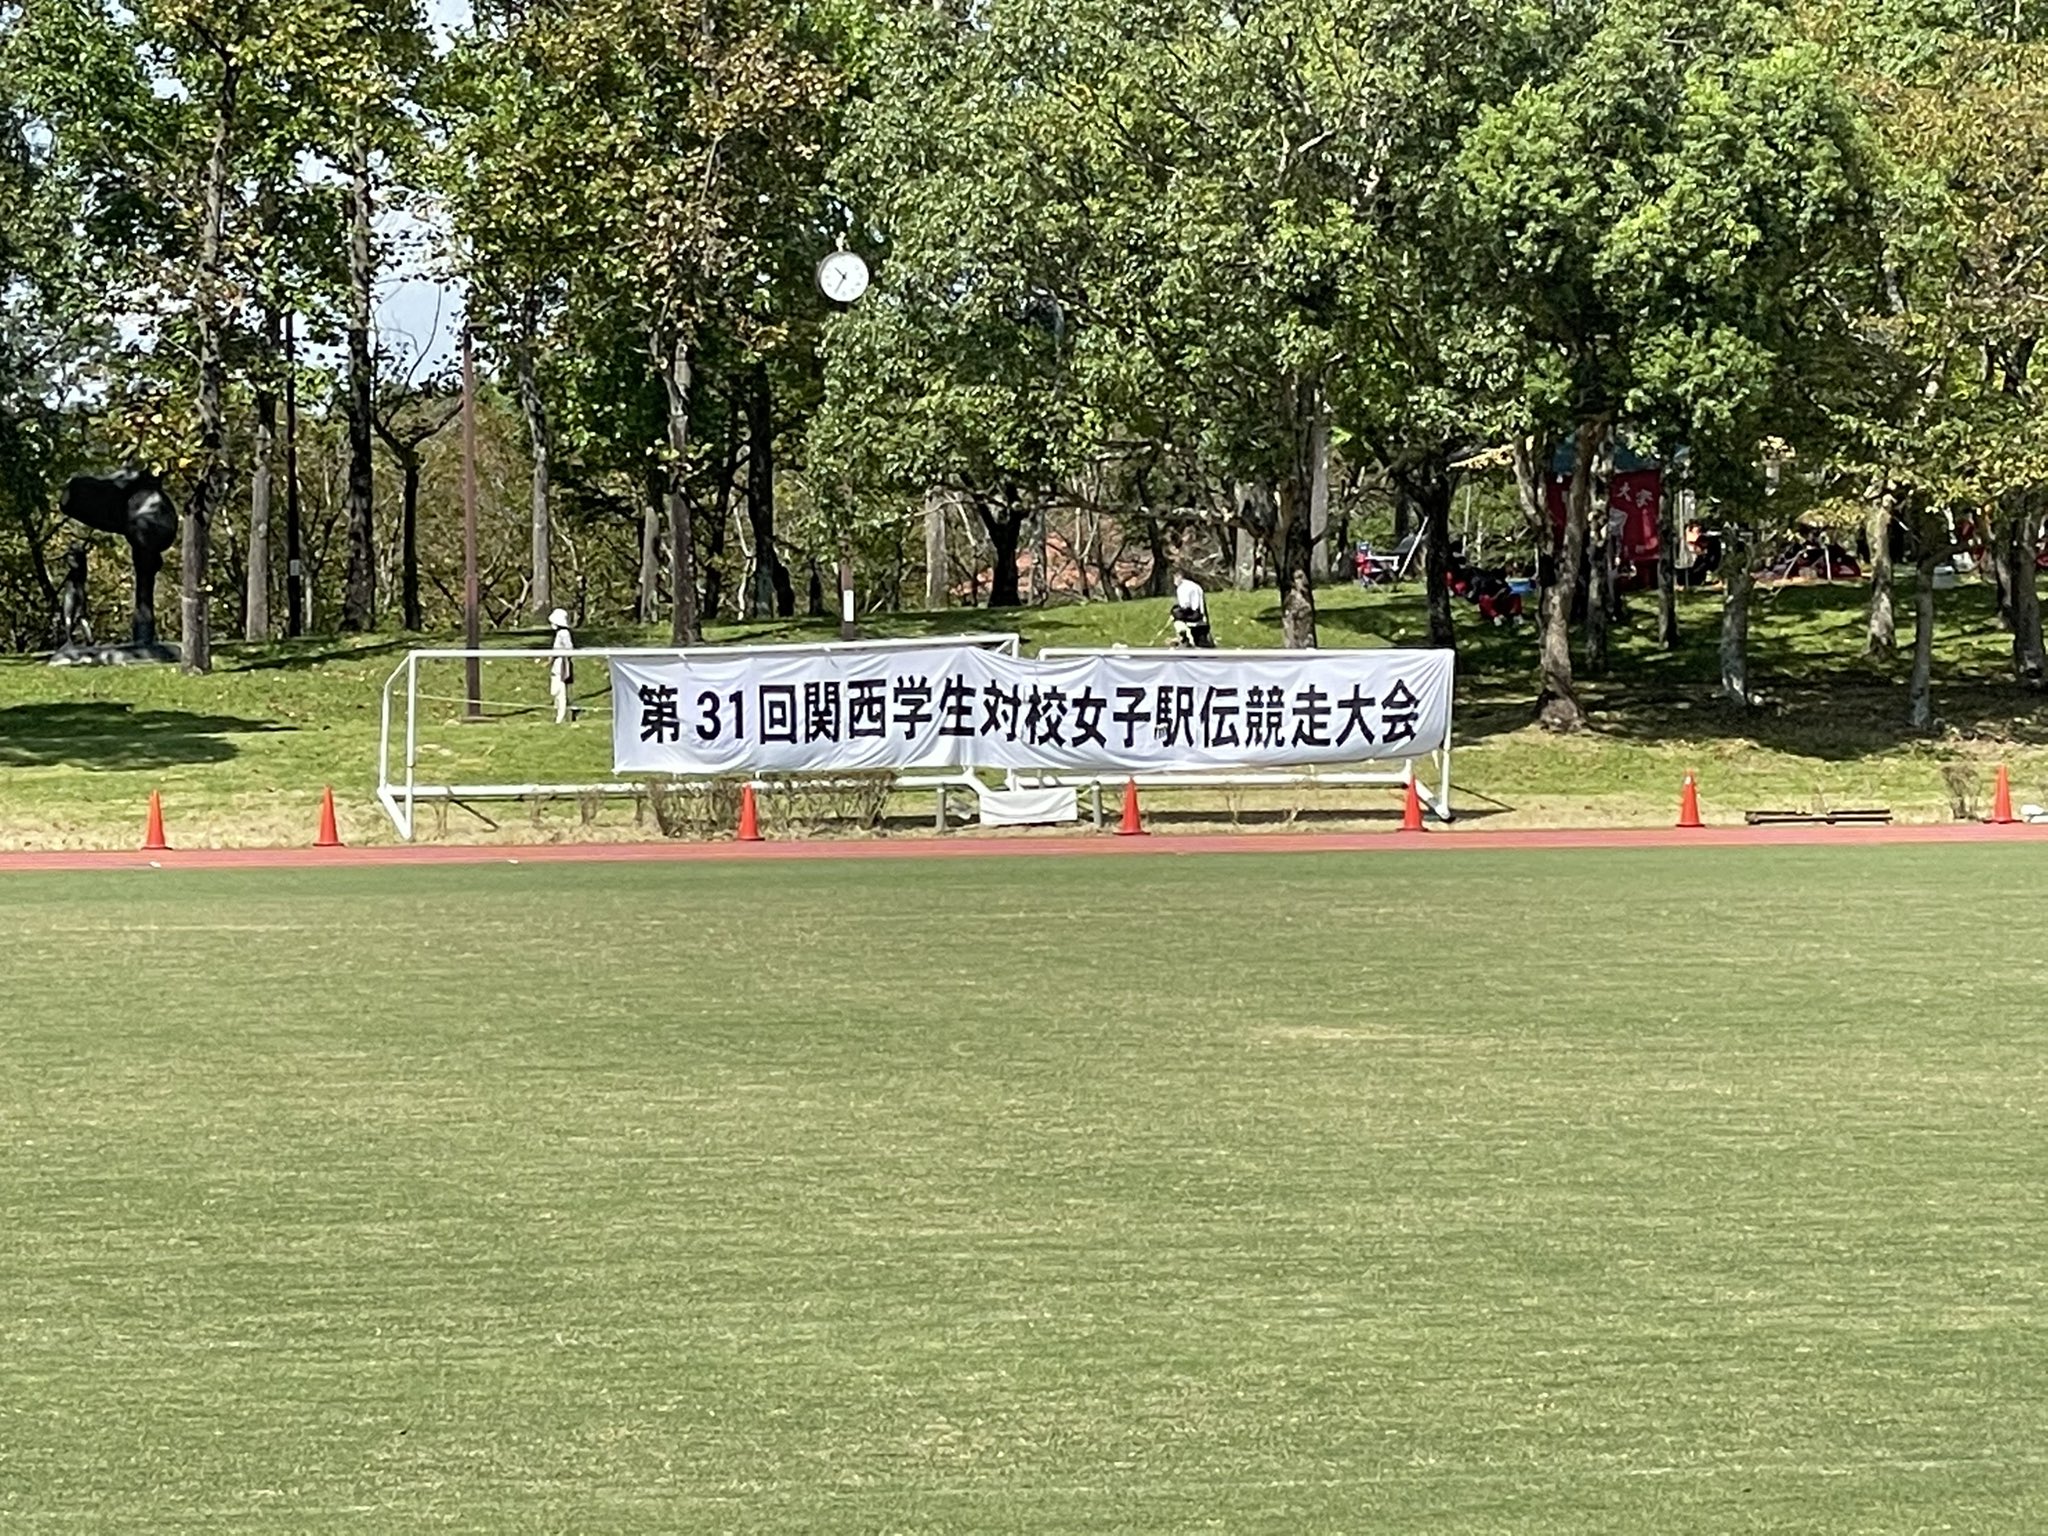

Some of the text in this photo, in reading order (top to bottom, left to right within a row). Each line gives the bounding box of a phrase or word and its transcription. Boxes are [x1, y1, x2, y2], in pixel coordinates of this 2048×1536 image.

[638, 674, 1420, 749] 第31回関西学生対校女子駅伝競走大会
